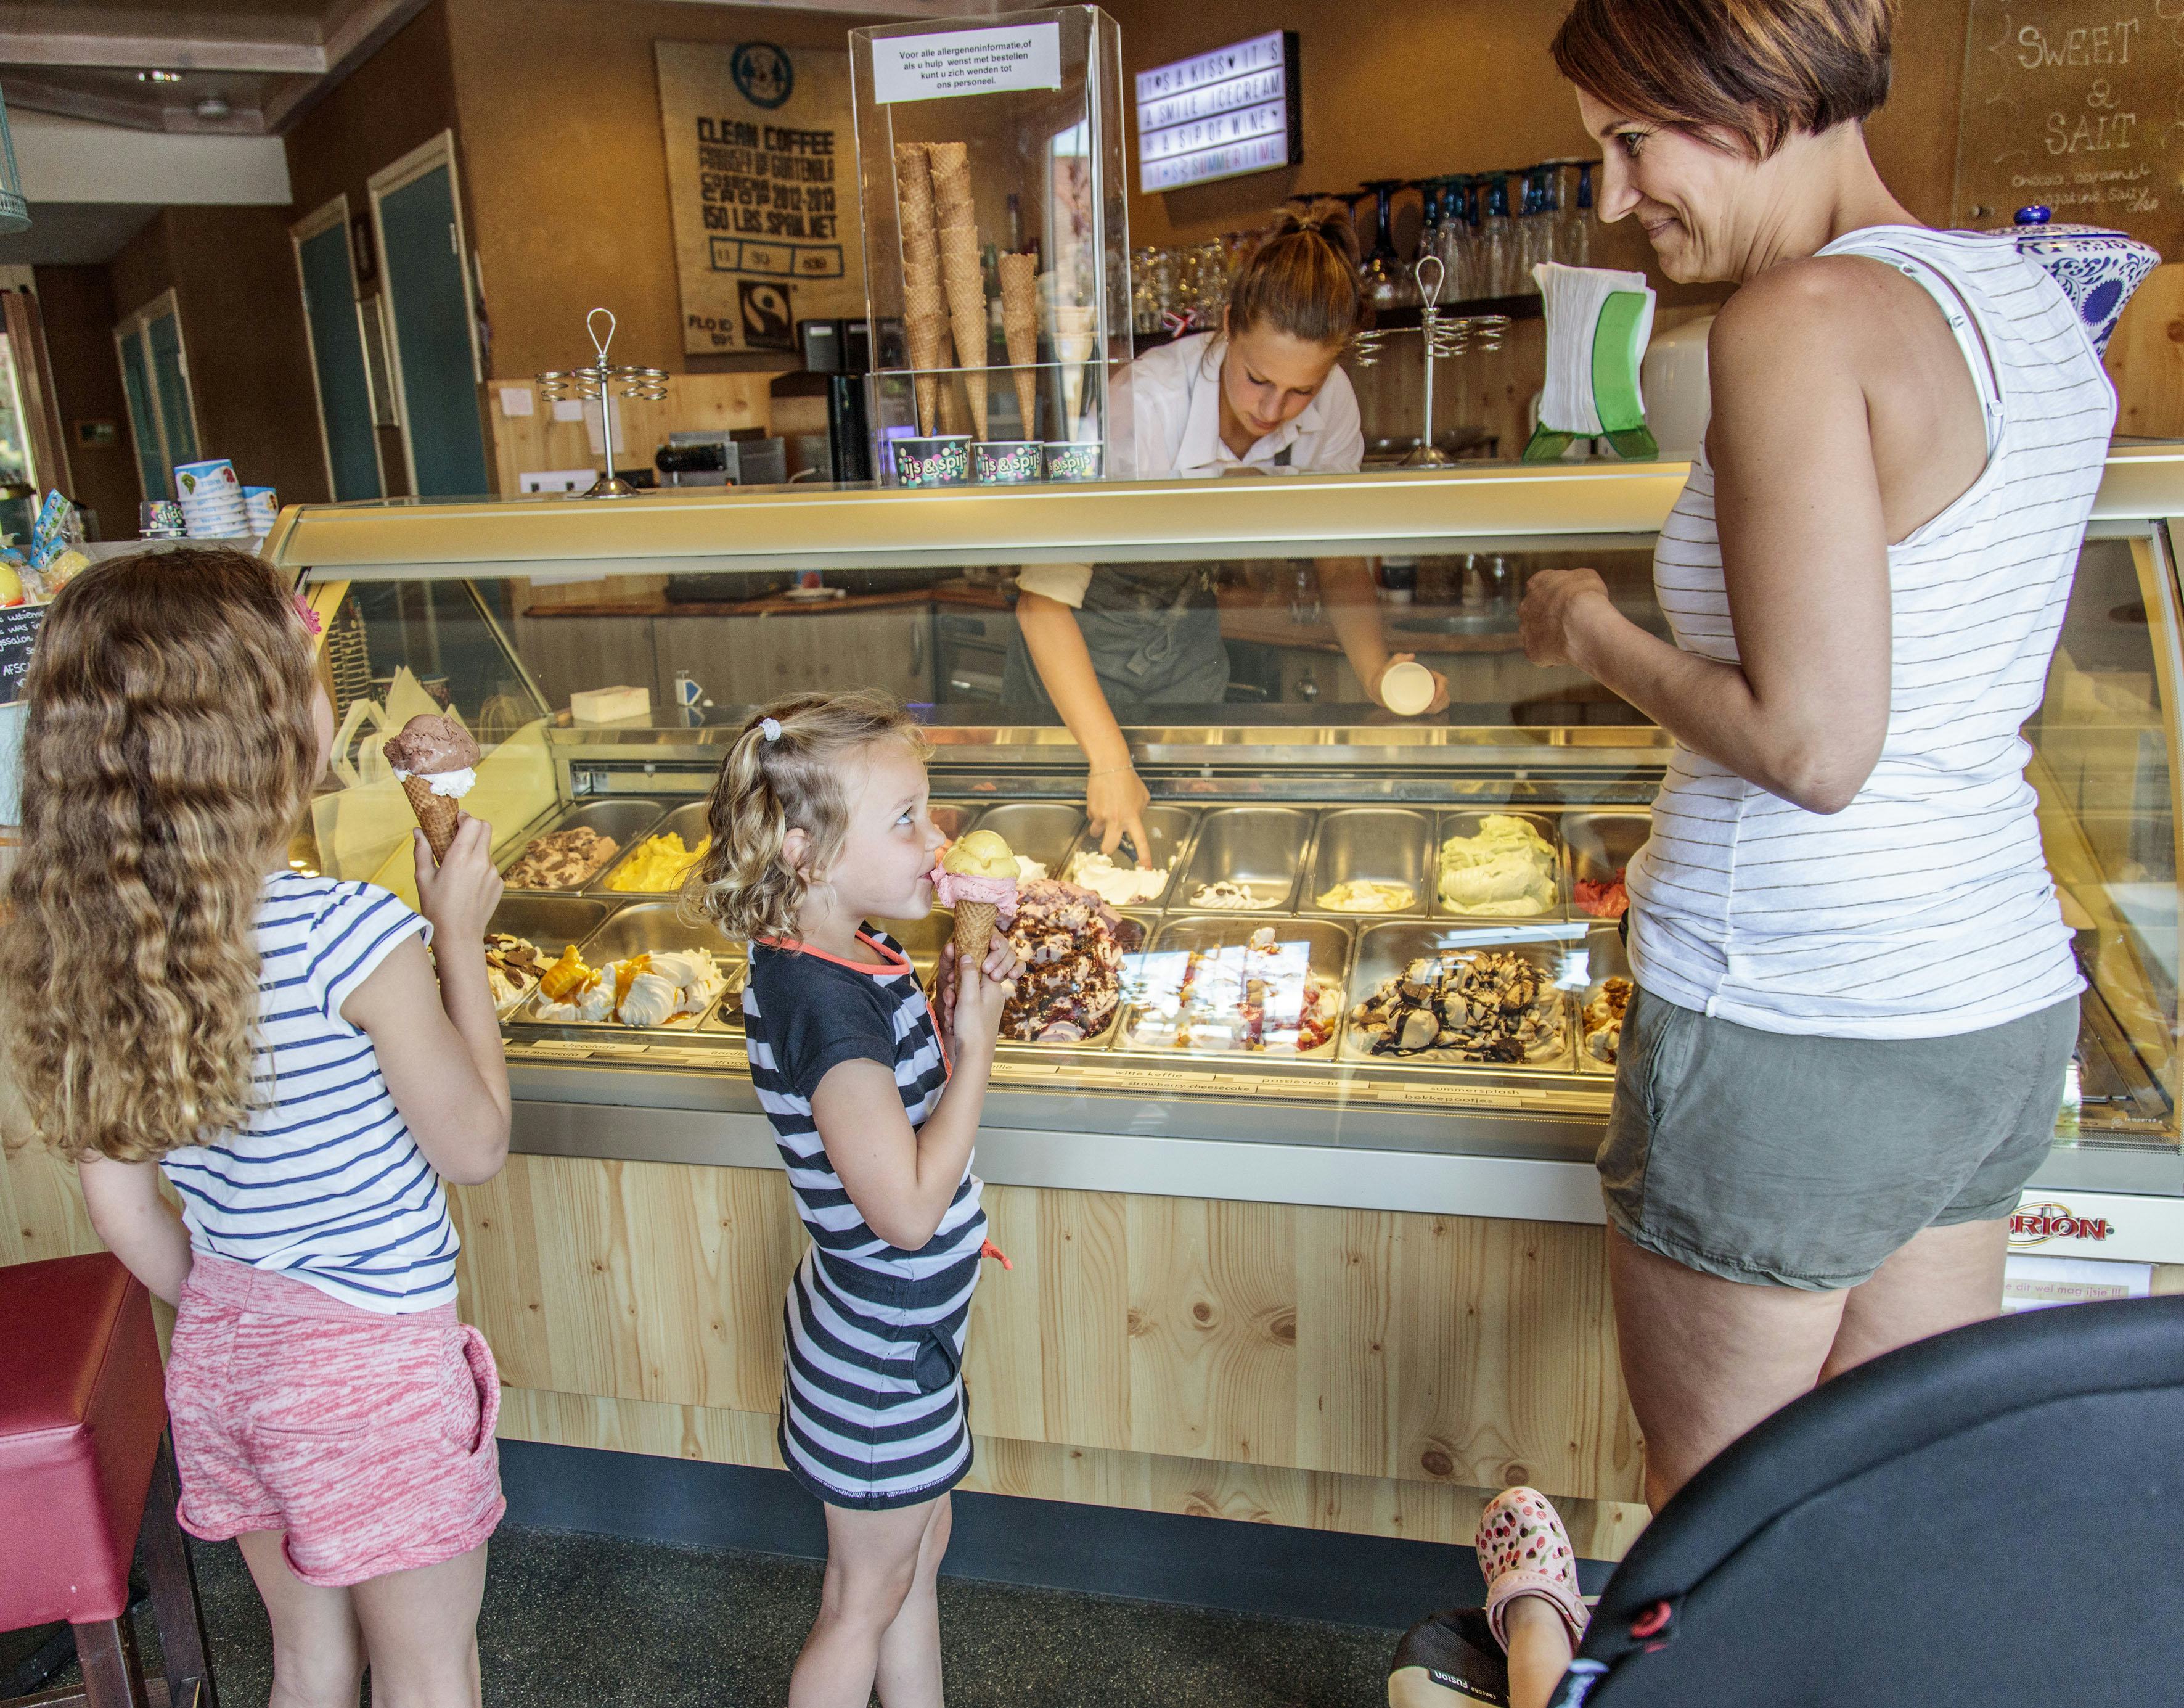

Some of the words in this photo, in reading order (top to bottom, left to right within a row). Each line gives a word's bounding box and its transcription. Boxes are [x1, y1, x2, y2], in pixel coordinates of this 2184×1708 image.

[2017, 17, 2139, 69] SWEET
[899, 51, 919, 60] Voor
[921, 49, 935, 57] alle
[904, 62, 917, 70] als
[925, 60, 943, 70] hulp
[947, 57, 972, 67] wenst
[973, 55, 989, 64] met
[991, 52, 1029, 63] bestellen
[921, 70, 939, 80] kunt
[948, 67, 965, 77] zich
[967, 65, 999, 76] wenden
[1001, 65, 1012, 73] tot
[1176, 68, 1185, 88] A
[1190, 55, 1225, 84] KISS
[936, 81, 952, 89] ons
[954, 77, 997, 90] personeel.
[1145, 107, 1153, 127] A
[1211, 72, 1281, 111] ICECREAM
[2087, 78, 2122, 109] &
[697, 117, 758, 148] CLEAN
[764, 125, 835, 155] COFFEE
[1163, 133, 1170, 153] A
[1179, 123, 1203, 149] SIP
[1208, 118, 1224, 142] OF
[1232, 108, 1267, 136] WINE
[2044, 111, 2137, 154] SALT
[923, 461, 938, 475] &
[997, 459, 1011, 473] &
[1061, 453, 1090, 473] spijs
[562, 1042, 616, 1050] chocolade
[530, 1050, 579, 1058] maracuja
[1128, 1081, 1186, 1090] strawberry
[1262, 1078, 1339, 1086] passievrucht
[1430, 1086, 1520, 1095] summersplash
[1404, 1094, 1494, 1104] bokkepootjes
[2016, 1281, 2031, 1292] dit
[2035, 1283, 2054, 1294] wel
[2057, 1287, 2082, 1299] mag
[2086, 1286, 2108, 1299] ijsje
[2111, 1287, 2121, 1297] !!!
